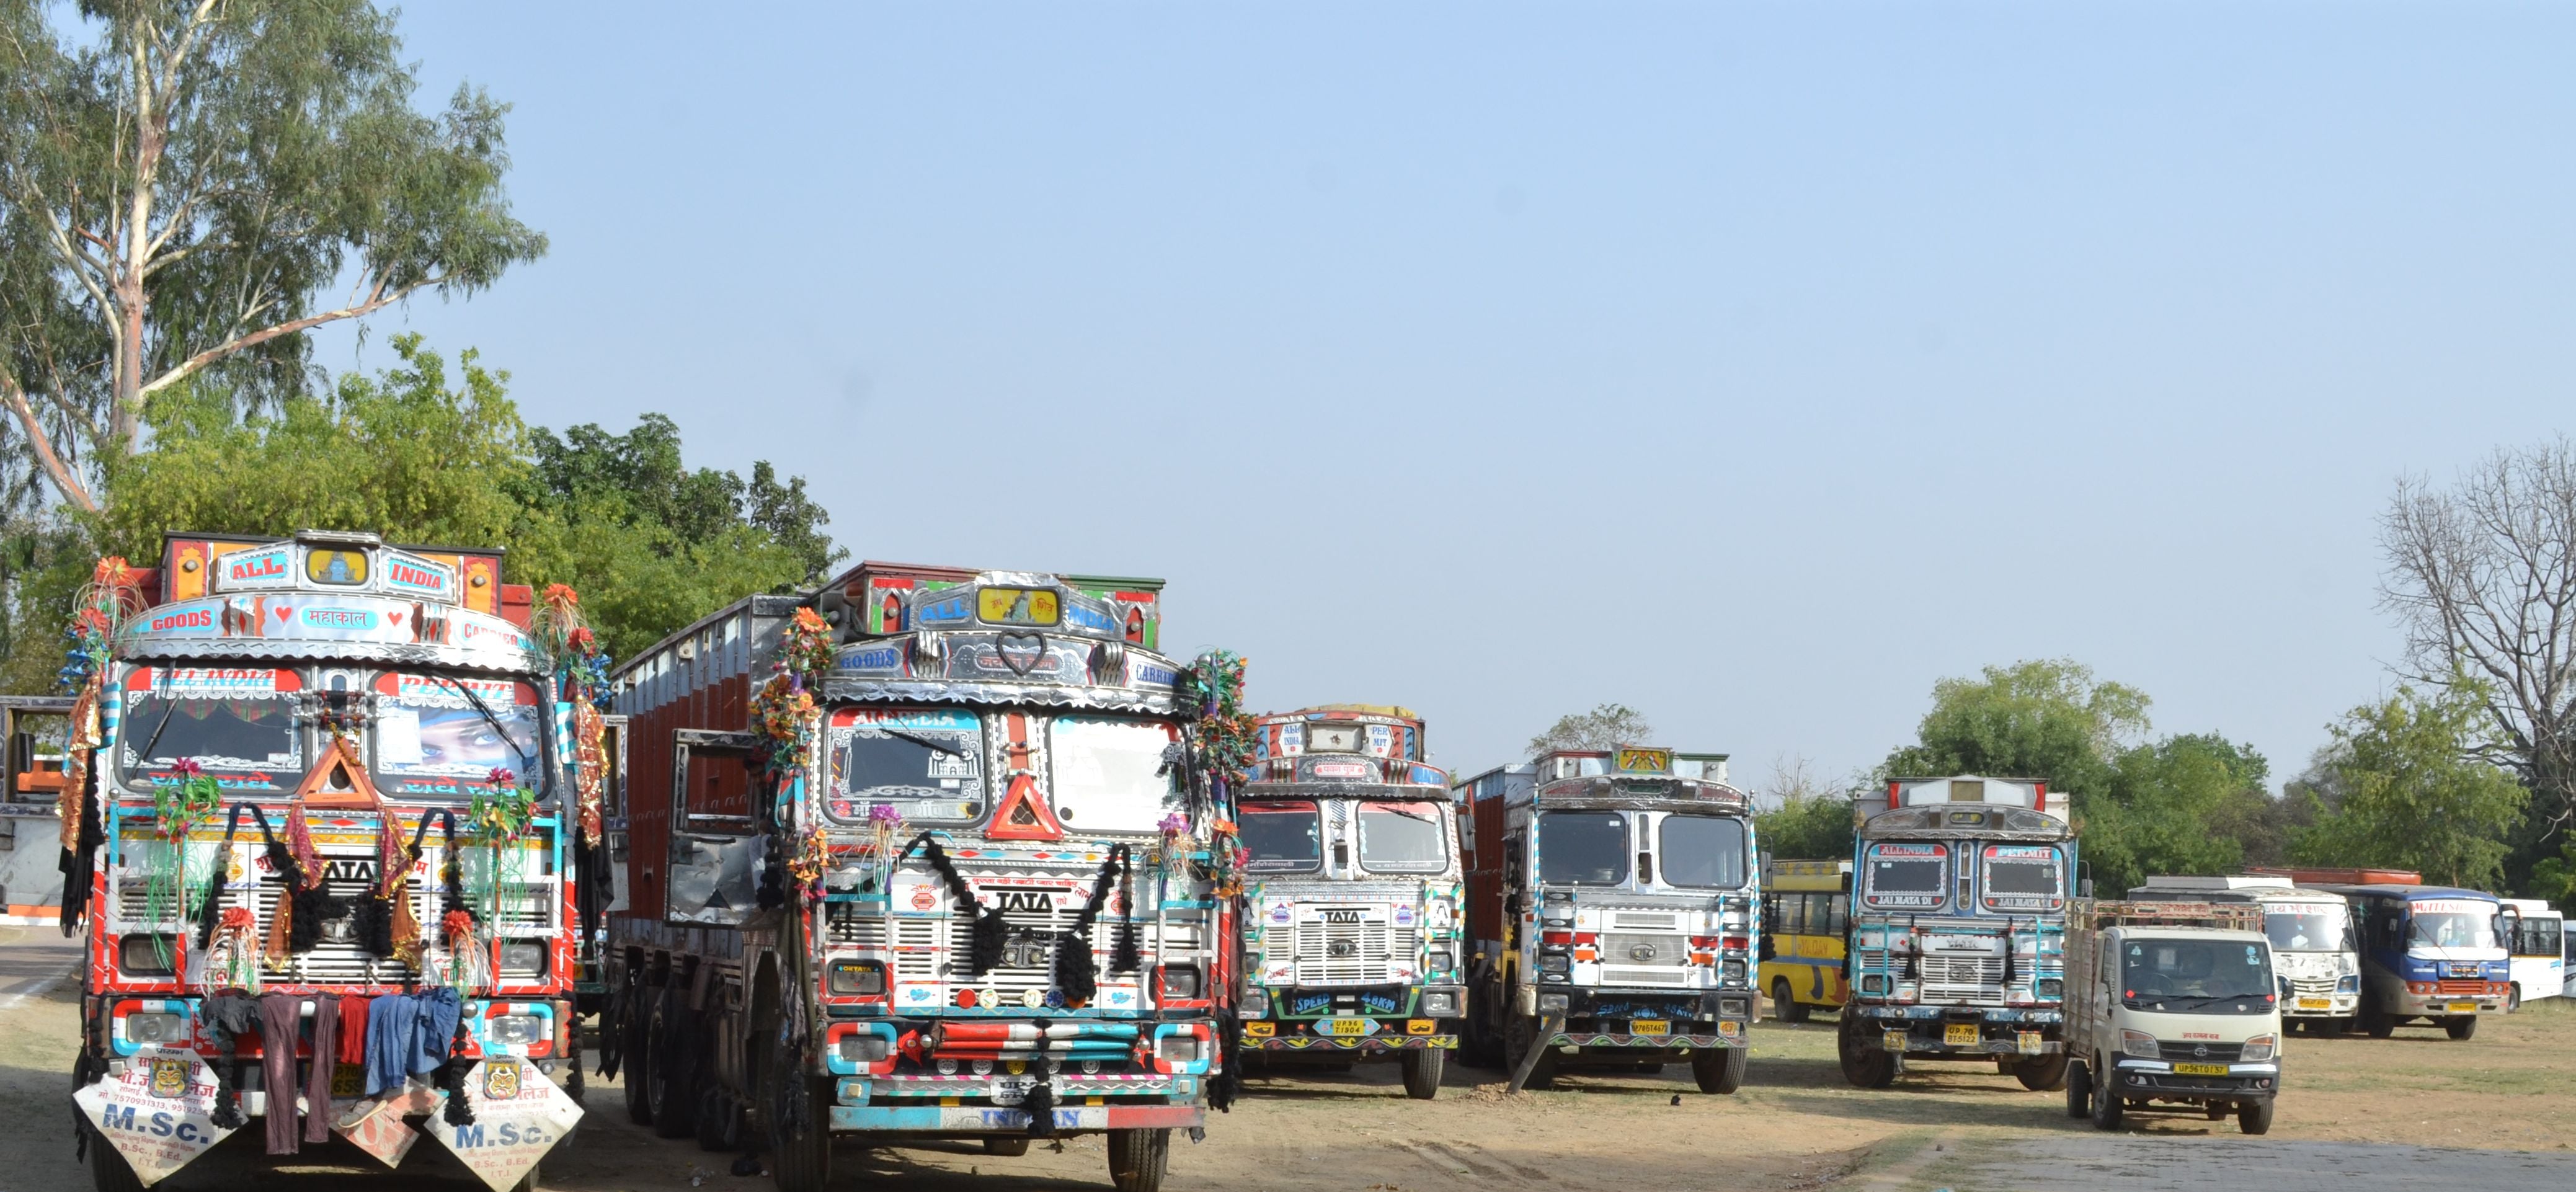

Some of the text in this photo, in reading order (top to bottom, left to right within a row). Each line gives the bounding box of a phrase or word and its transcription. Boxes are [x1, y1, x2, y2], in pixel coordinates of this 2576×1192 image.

[232, 558, 441, 589] ALL INDIA
[152, 610, 211, 631] GOODS
[309, 609, 367, 626] महाकाल
[920, 598, 1114, 633] ALL INDIA
[840, 648, 895, 669] GOODS
[153, 670, 274, 687] ALL INDIA
[1136, 664, 1181, 686] CARRIE
[399, 677, 512, 700] PERMIT
[852, 711, 957, 727] ALL INDIA
[1284, 726, 1300, 734] ALL
[1372, 727, 1388, 736] PER
[1284, 737, 1301, 745] INDIA
[1373, 738, 1388, 747] MIT
[1880, 845, 1934, 855] ALL INDIA
[1998, 848, 2051, 858] PERMIT
[321, 861, 373, 879] ATA
[997, 892, 1052, 909] TATA
[1878, 896, 1932, 905] JAI MATA DI
[1325, 911, 1360, 923] TATA
[1296, 994, 1330, 1012] SPEED
[102, 1103, 209, 1144] M.Sc.
[456, 1122, 553, 1149] M.Sc.
[156, 1149, 182, 1162] B.Ed.
[506, 1157, 530, 1167] B.Ed.
